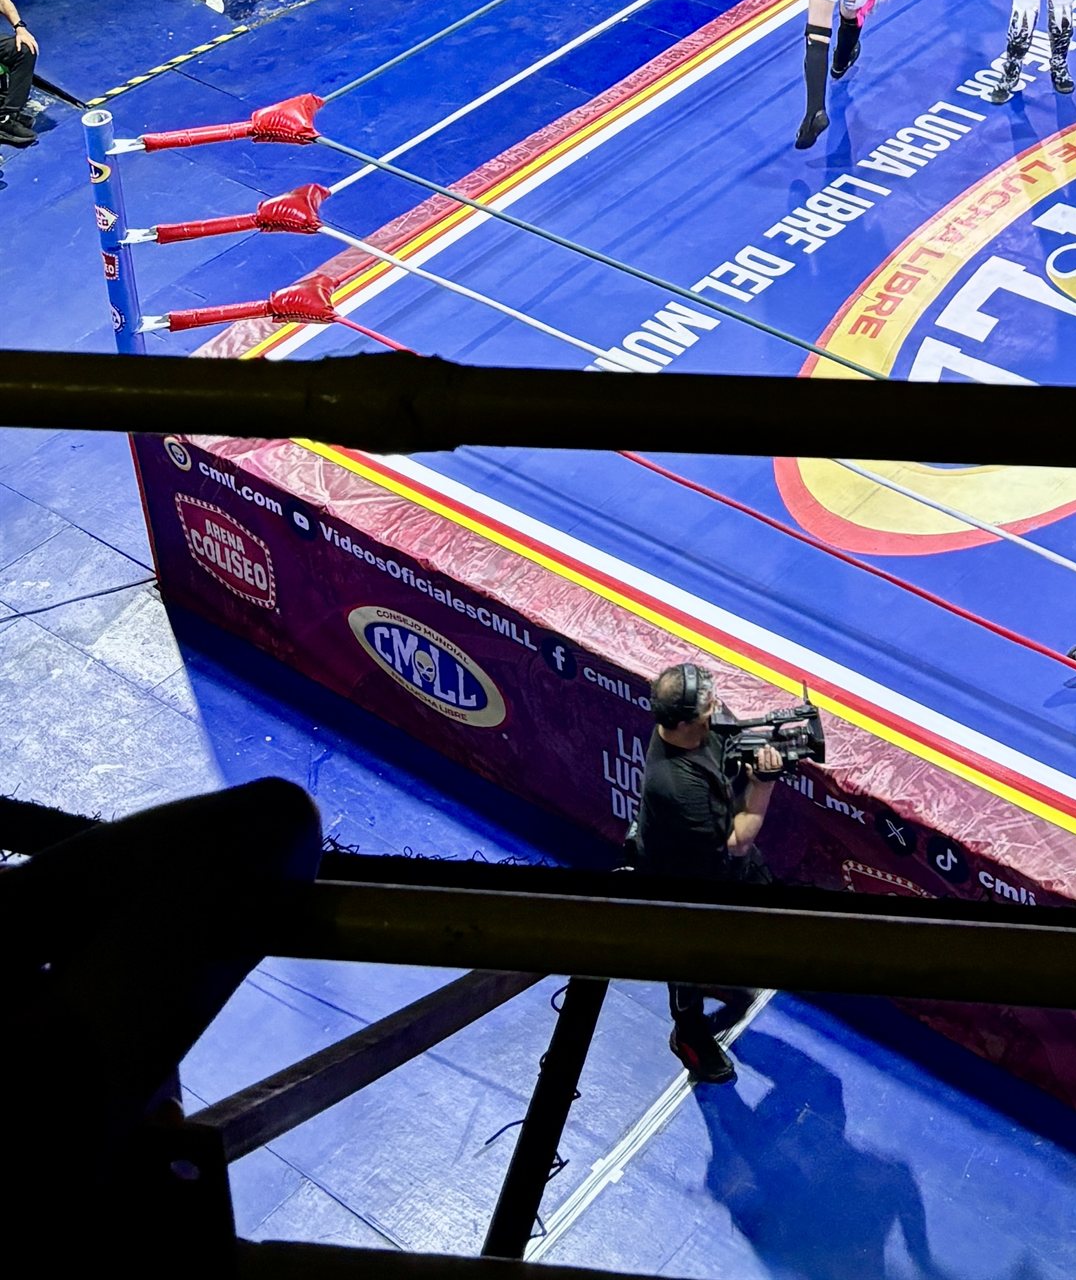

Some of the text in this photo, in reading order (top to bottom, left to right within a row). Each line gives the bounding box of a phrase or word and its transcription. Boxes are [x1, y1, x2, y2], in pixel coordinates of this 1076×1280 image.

[856, 101, 987, 178] LUCHA
[763, 174, 892, 254] LIBRE
[690, 245, 796, 303] DEL
[848, 246, 945, 339] LIBRE
[190, 528, 268, 592] COLISEO
[198, 462, 283, 517] cmll.com
[319, 521, 538, 651] VideosOficialesCMLL
[205, 518, 245, 555] ARENA
[373, 625, 477, 707] CMLL
[376, 608, 470, 665] CONSEJO MUNDIAL
[439, 703, 468, 721] LIBRE
[617, 727, 646, 768] LA
